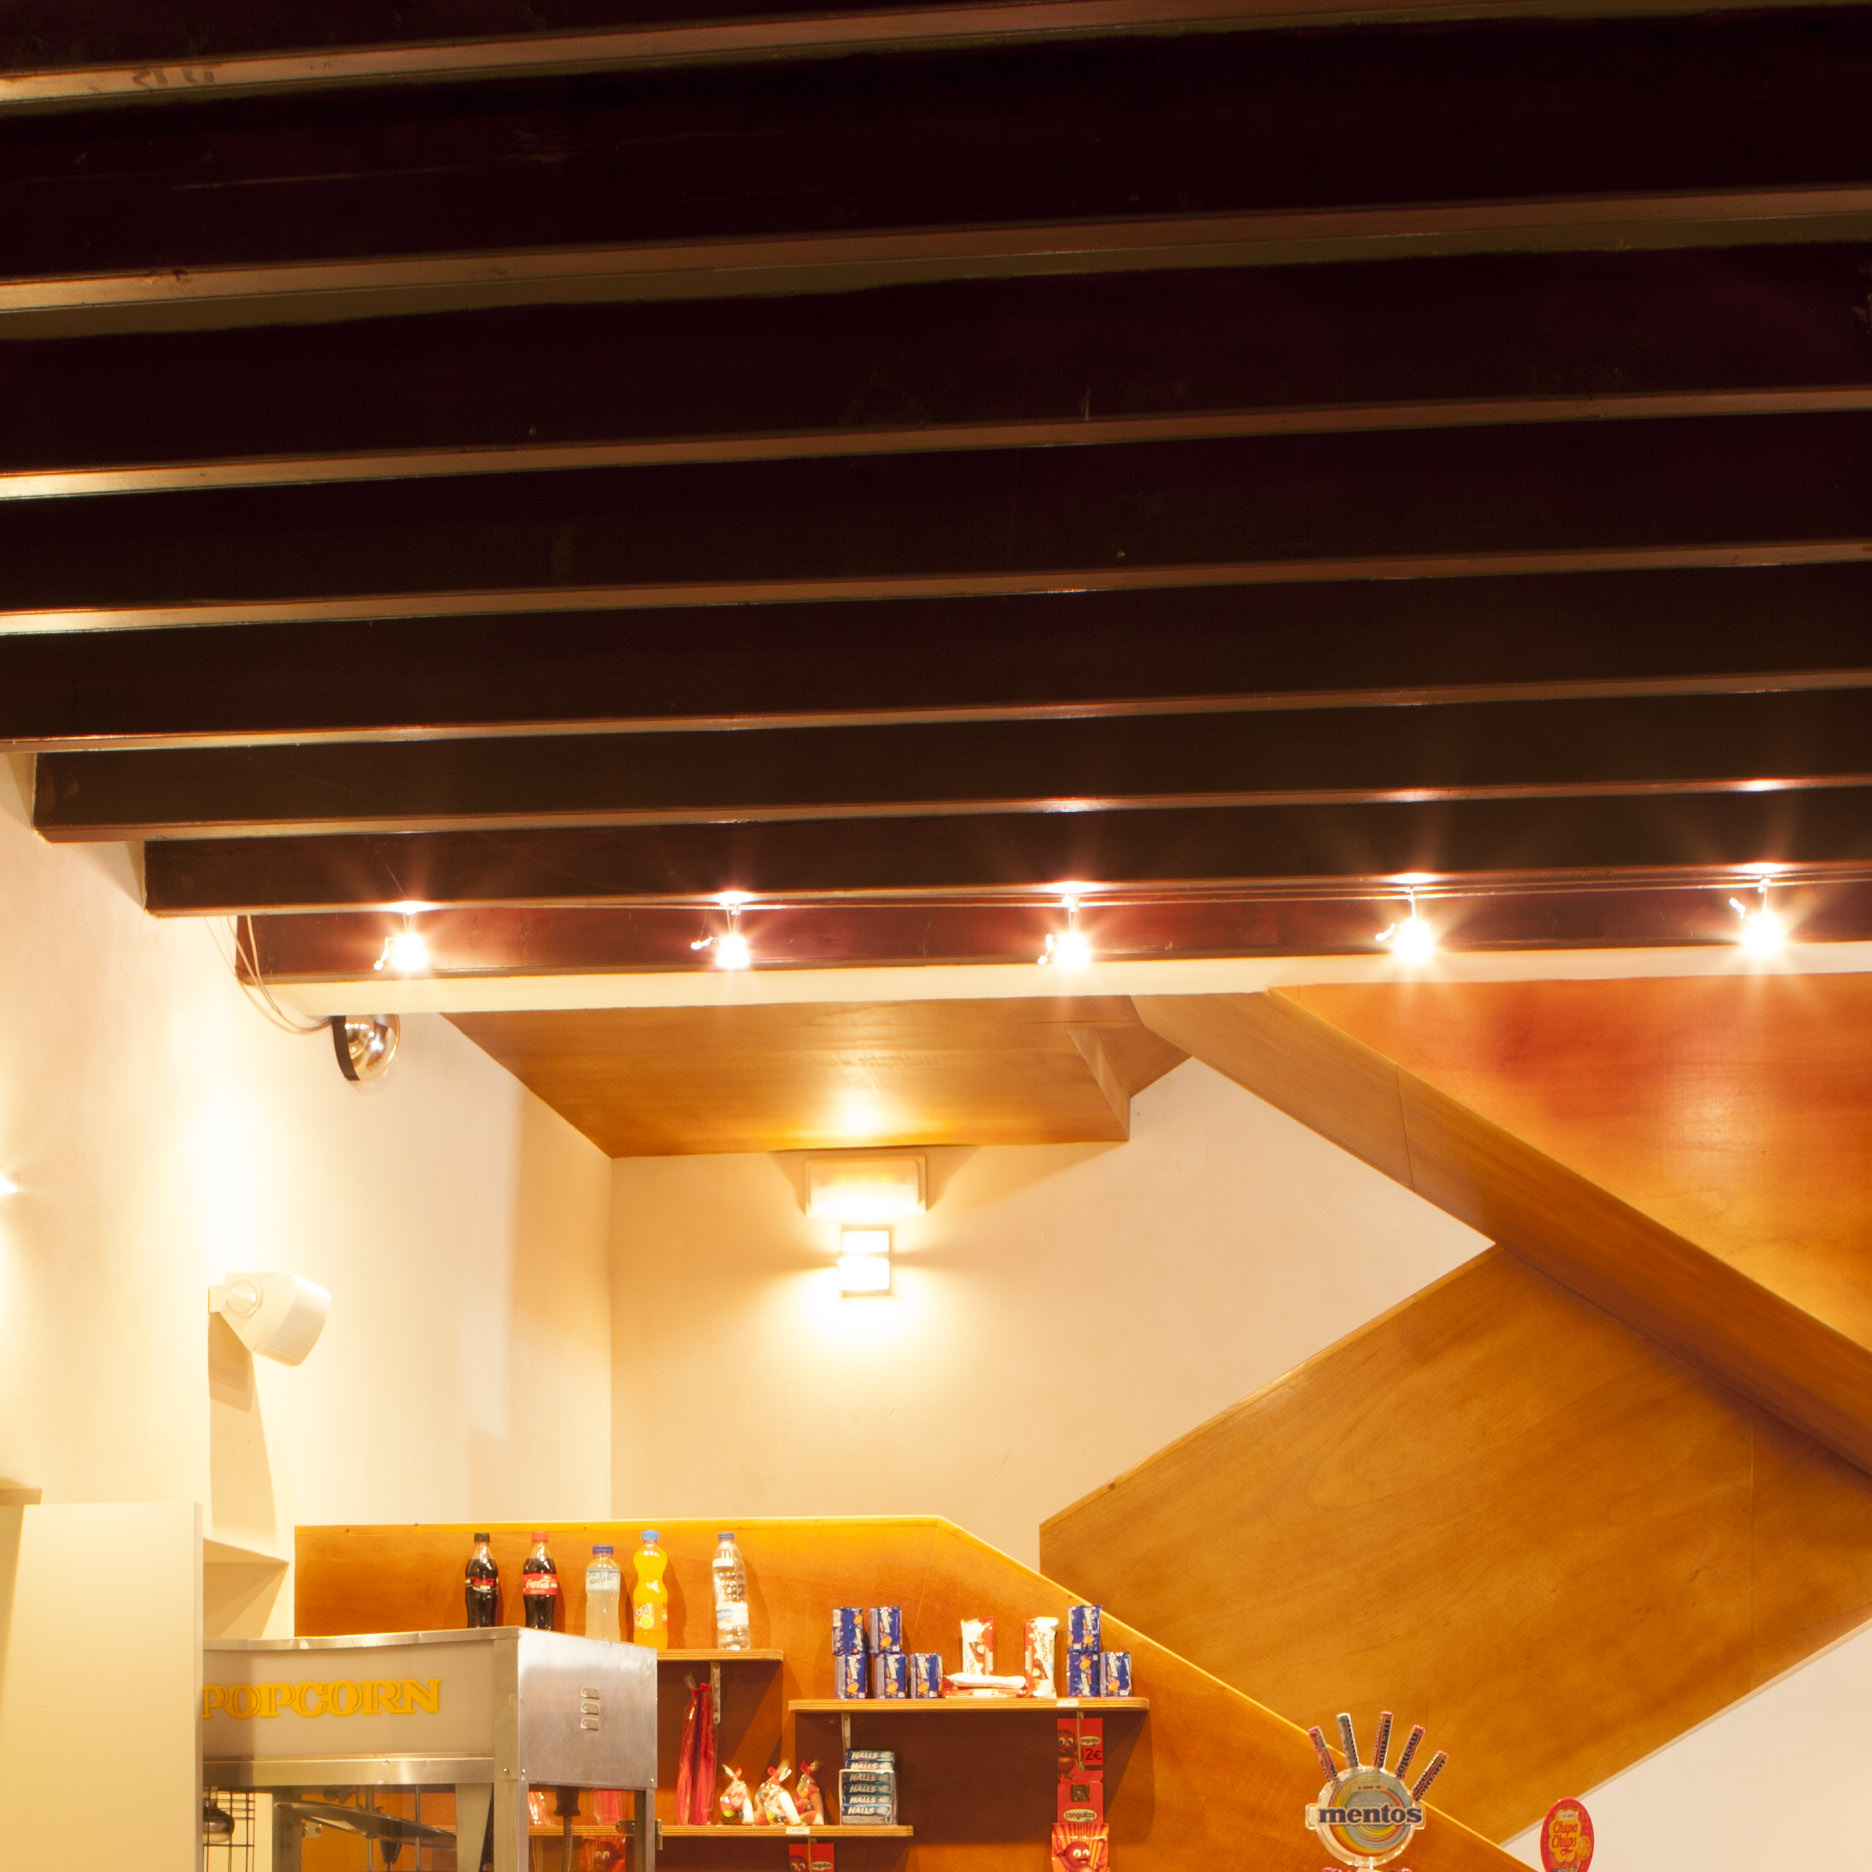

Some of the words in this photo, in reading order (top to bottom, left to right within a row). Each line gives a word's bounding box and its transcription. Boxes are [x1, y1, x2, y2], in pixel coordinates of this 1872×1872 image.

[201, 1679, 441, 1720] POPCORN
[1378, 1719, 1391, 1768] mentos
[851, 1751, 878, 1760] HALLS
[849, 1773, 876, 1782] HALLS
[849, 1784, 876, 1793] HALLS
[849, 1796, 876, 1804] HALLS
[847, 1806, 875, 1815] HALLS
[1319, 1803, 1422, 1823] mentos
[1553, 1821, 1578, 1836] Chupa
[1551, 1834, 1577, 1856] Chups
